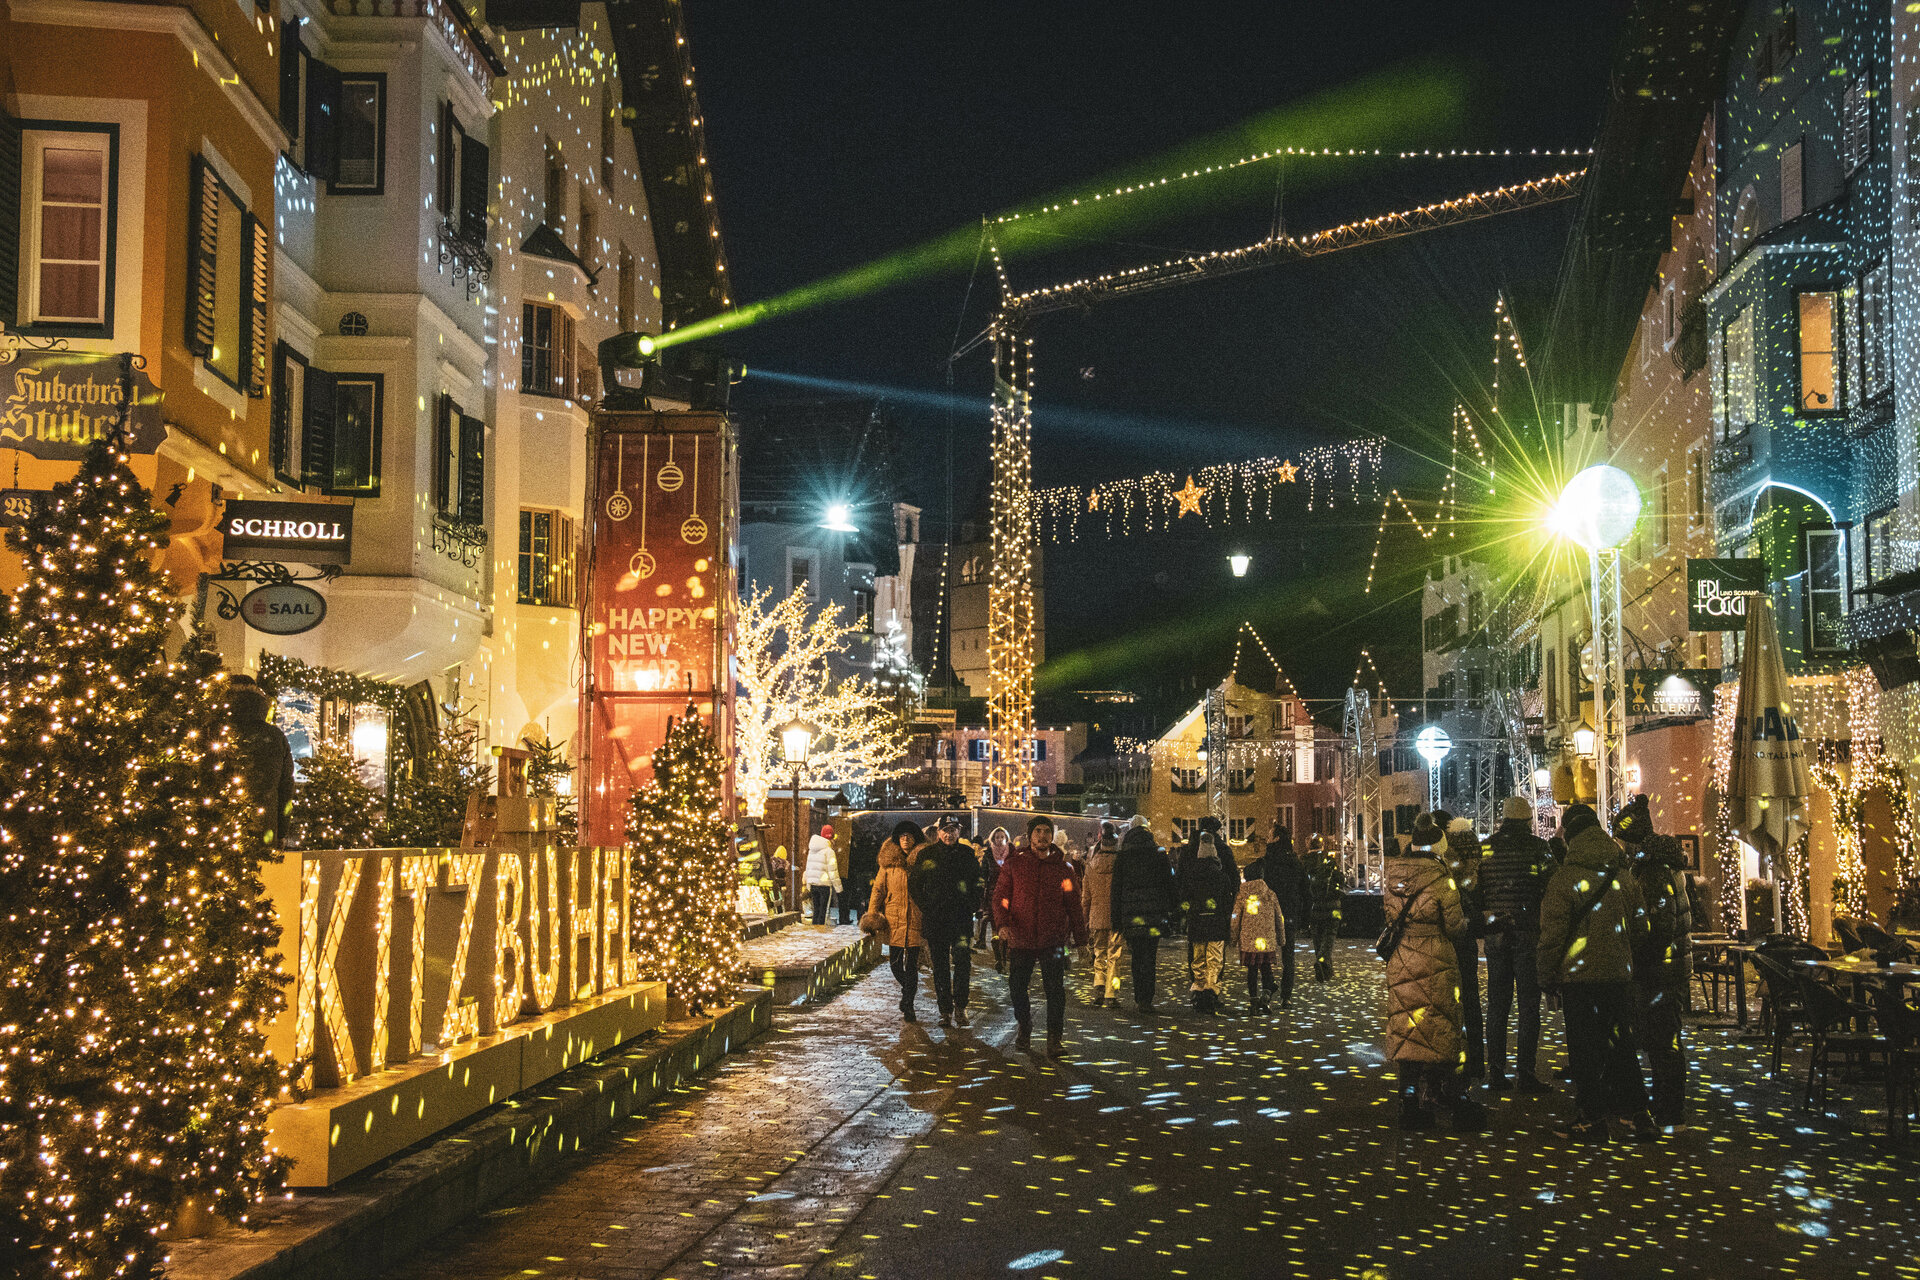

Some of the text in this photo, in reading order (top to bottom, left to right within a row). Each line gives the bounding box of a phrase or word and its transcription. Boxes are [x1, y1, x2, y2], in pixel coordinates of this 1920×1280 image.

[229, 518, 346, 540] SCHROLL
[269, 603, 315, 615] SAAL
[608, 607, 703, 630] HAPPY
[608, 633, 673, 656] NEW
[1632, 704, 1702, 713] GALLERIA
